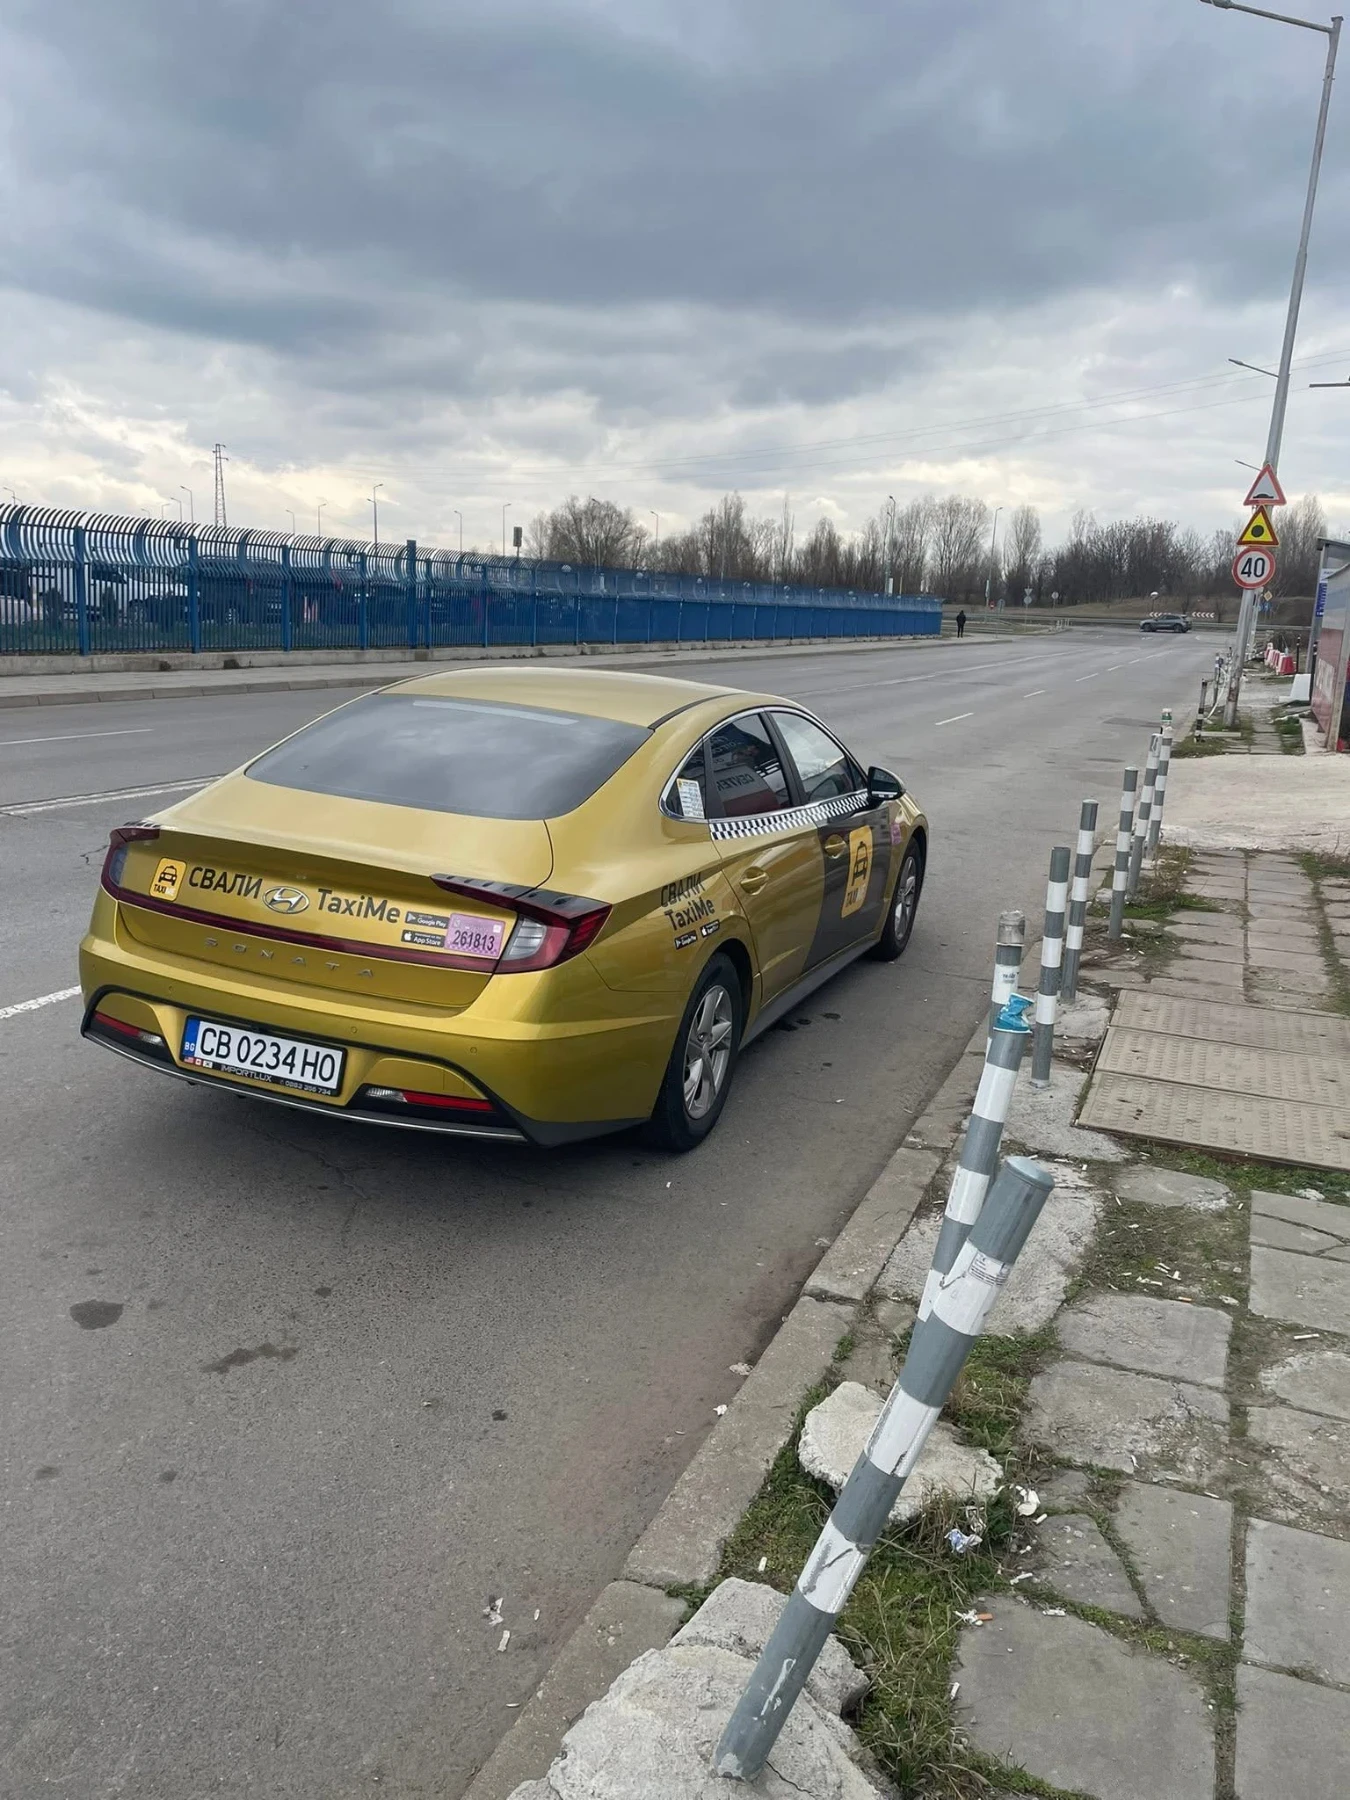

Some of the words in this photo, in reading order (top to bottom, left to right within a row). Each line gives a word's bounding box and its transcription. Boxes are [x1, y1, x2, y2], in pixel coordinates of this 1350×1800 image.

[1240, 557, 1265, 578] 40
[188, 866, 263, 900] СВАЛИ
[660, 872, 705, 907] СВАЛИ
[318, 888, 401, 924] TaxiMe
[664, 896, 716, 931] TaxiMe
[435, 920, 447, 928] Play
[413, 936, 425, 945] App
[425, 937, 441, 946] Store
[453, 930, 495, 951] 261813
[205, 937, 374, 978] SONATA
[184, 1042, 195, 1051] BG
[200, 1027, 232, 1059] CB
[237, 1035, 297, 1074] 0234
[221, 1064, 272, 1082] IMPORTLUX
